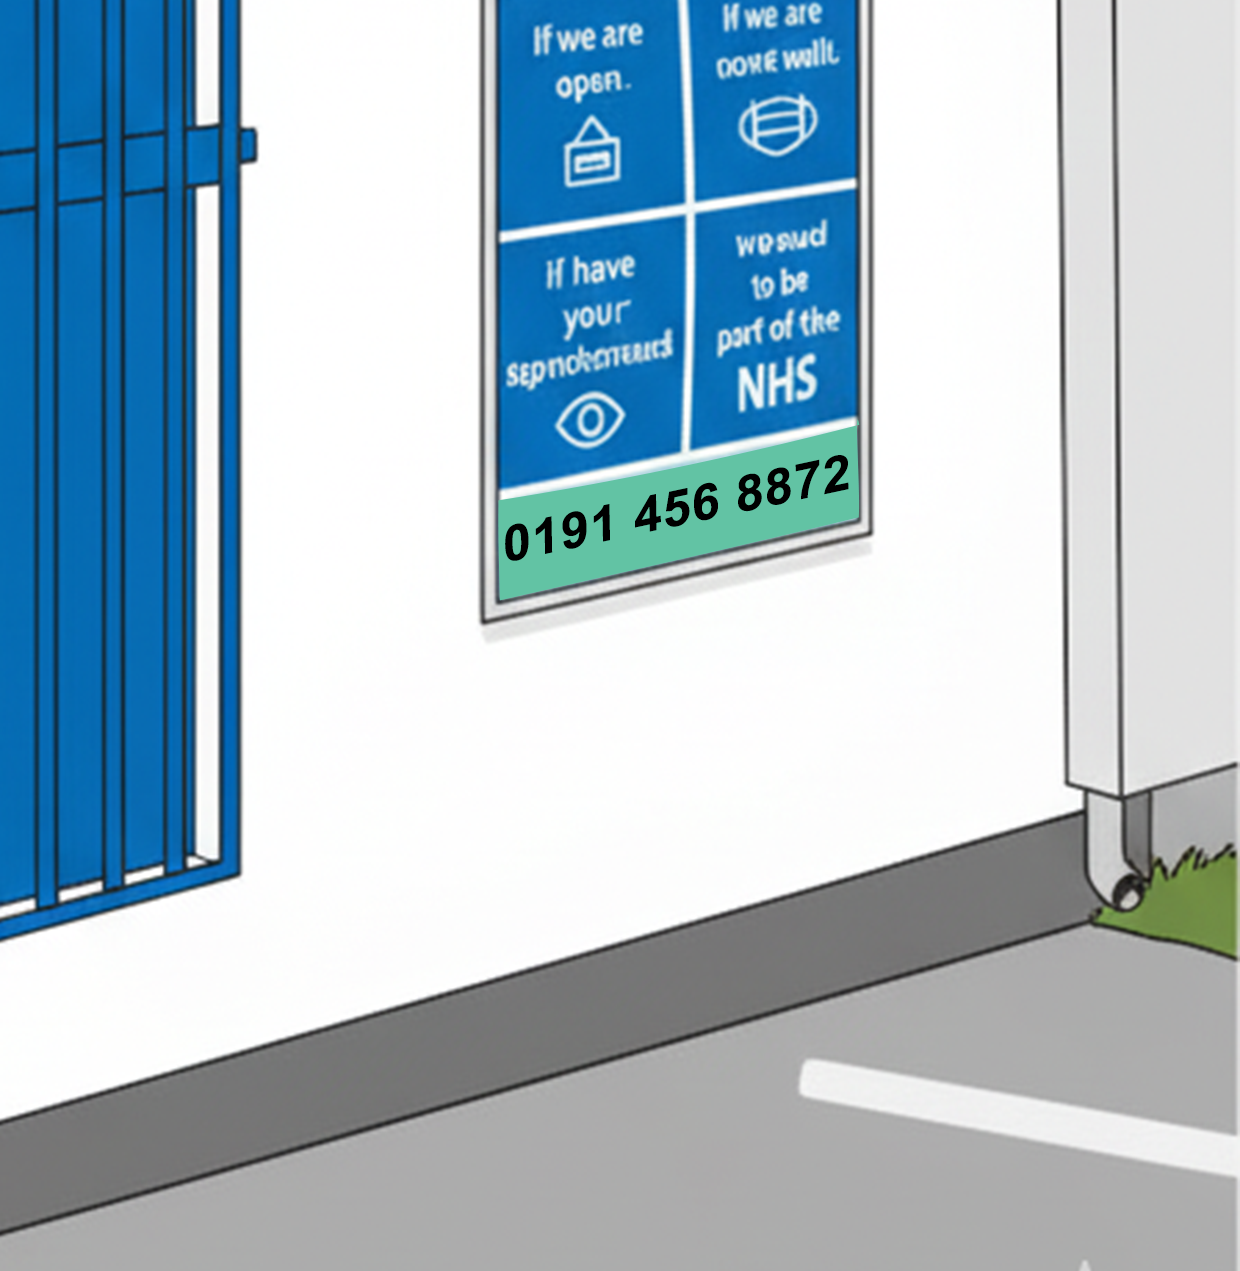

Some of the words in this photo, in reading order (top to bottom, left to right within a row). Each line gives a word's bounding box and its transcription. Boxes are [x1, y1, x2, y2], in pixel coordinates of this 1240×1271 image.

[722, 2, 740, 32] If
[744, 6, 778, 29] we
[784, 2, 823, 26] are
[533, 24, 553, 56] If
[556, 27, 596, 52] we
[601, 23, 644, 48] are
[572, 255, 635, 285] have
[751, 275, 775, 300] to
[780, 267, 809, 296] be
[562, 299, 631, 341] your
[717, 317, 764, 358] part
[768, 308, 795, 342] of
[799, 306, 841, 336] the
[738, 353, 818, 413] NHS
[504, 503, 612, 561] 0191
[634, 482, 719, 532] 456
[737, 454, 849, 512] 8872
